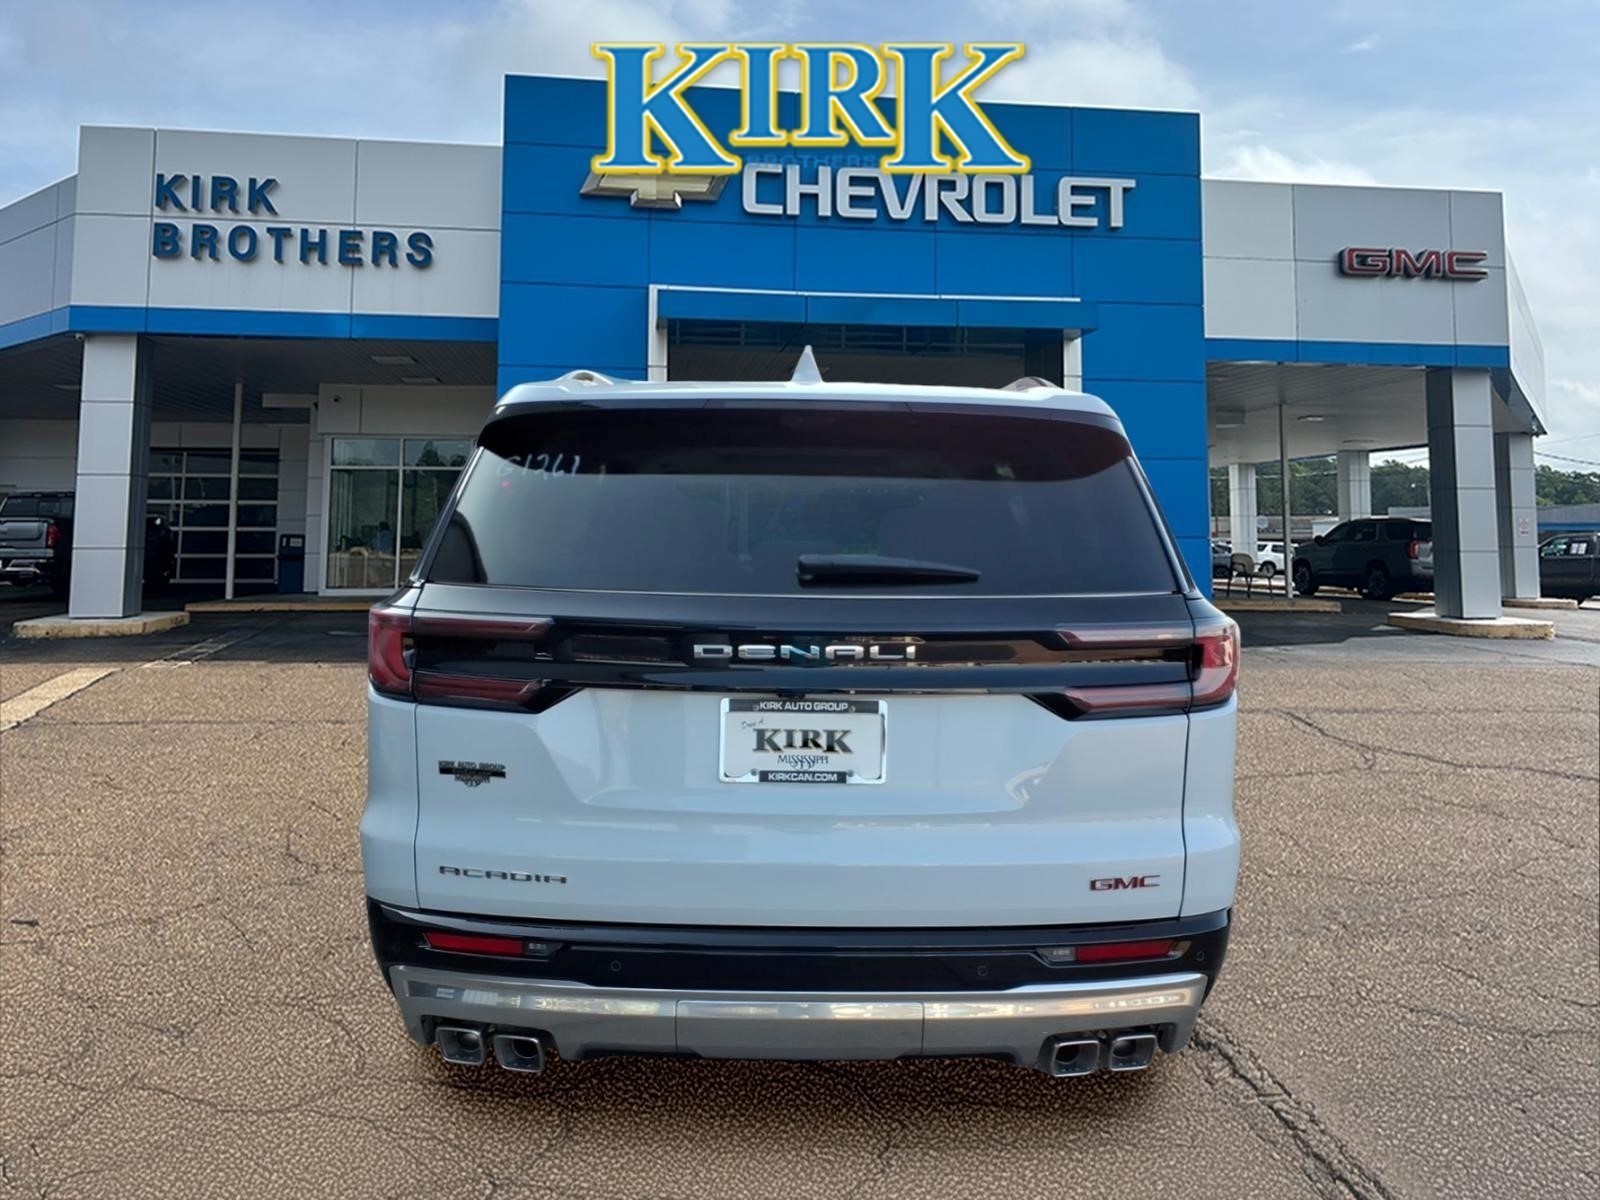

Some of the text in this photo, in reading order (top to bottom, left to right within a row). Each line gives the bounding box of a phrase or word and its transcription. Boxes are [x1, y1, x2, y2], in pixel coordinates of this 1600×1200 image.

[155, 173, 280, 216] KIRK
[741, 163, 1137, 228] CHEVROLET
[152, 221, 434, 270] BROTHERS
[1340, 246, 1489, 281] GMC
[693, 644, 916, 660] DENALI
[759, 701, 849, 711] KIRK AUTO GROUP
[752, 728, 853, 754] KIRK
[768, 772, 838, 782] KIRKCAN.COM
[439, 865, 567, 884] ACADIA
[1090, 875, 1160, 891] GMC
